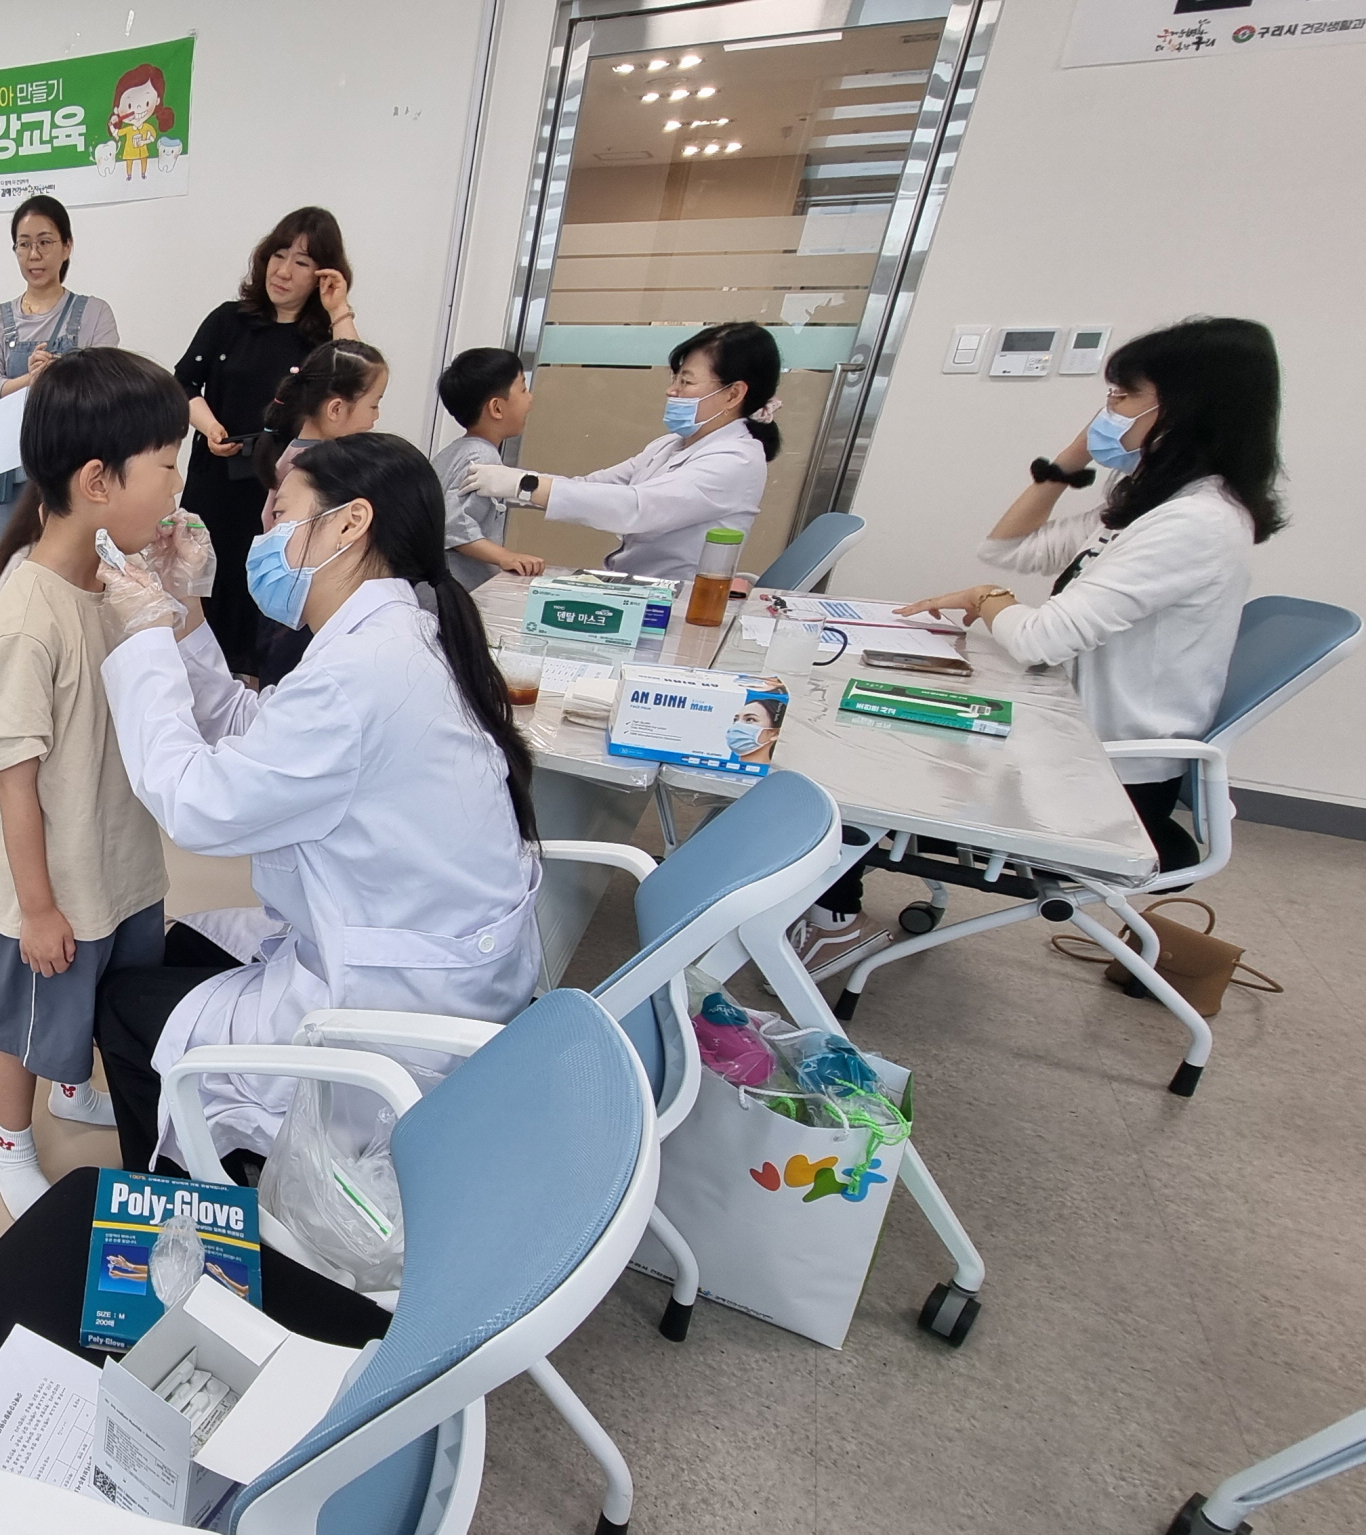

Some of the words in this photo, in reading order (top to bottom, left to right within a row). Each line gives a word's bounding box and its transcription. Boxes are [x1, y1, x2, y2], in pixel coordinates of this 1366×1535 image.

[1257, 23, 1299, 39] 구리시
[1301, 17, 1366, 35] 건강생활과
[16, 78, 63, 106] 만들기
[557, 610, 576, 623] 덴탈
[577, 613, 606, 626] 마스크
[630, 690, 650, 705] AN
[653, 692, 687, 709] BINH
[110, 1182, 244, 1230] Poly-Glove
[96, 1310, 111, 1318] SIZE
